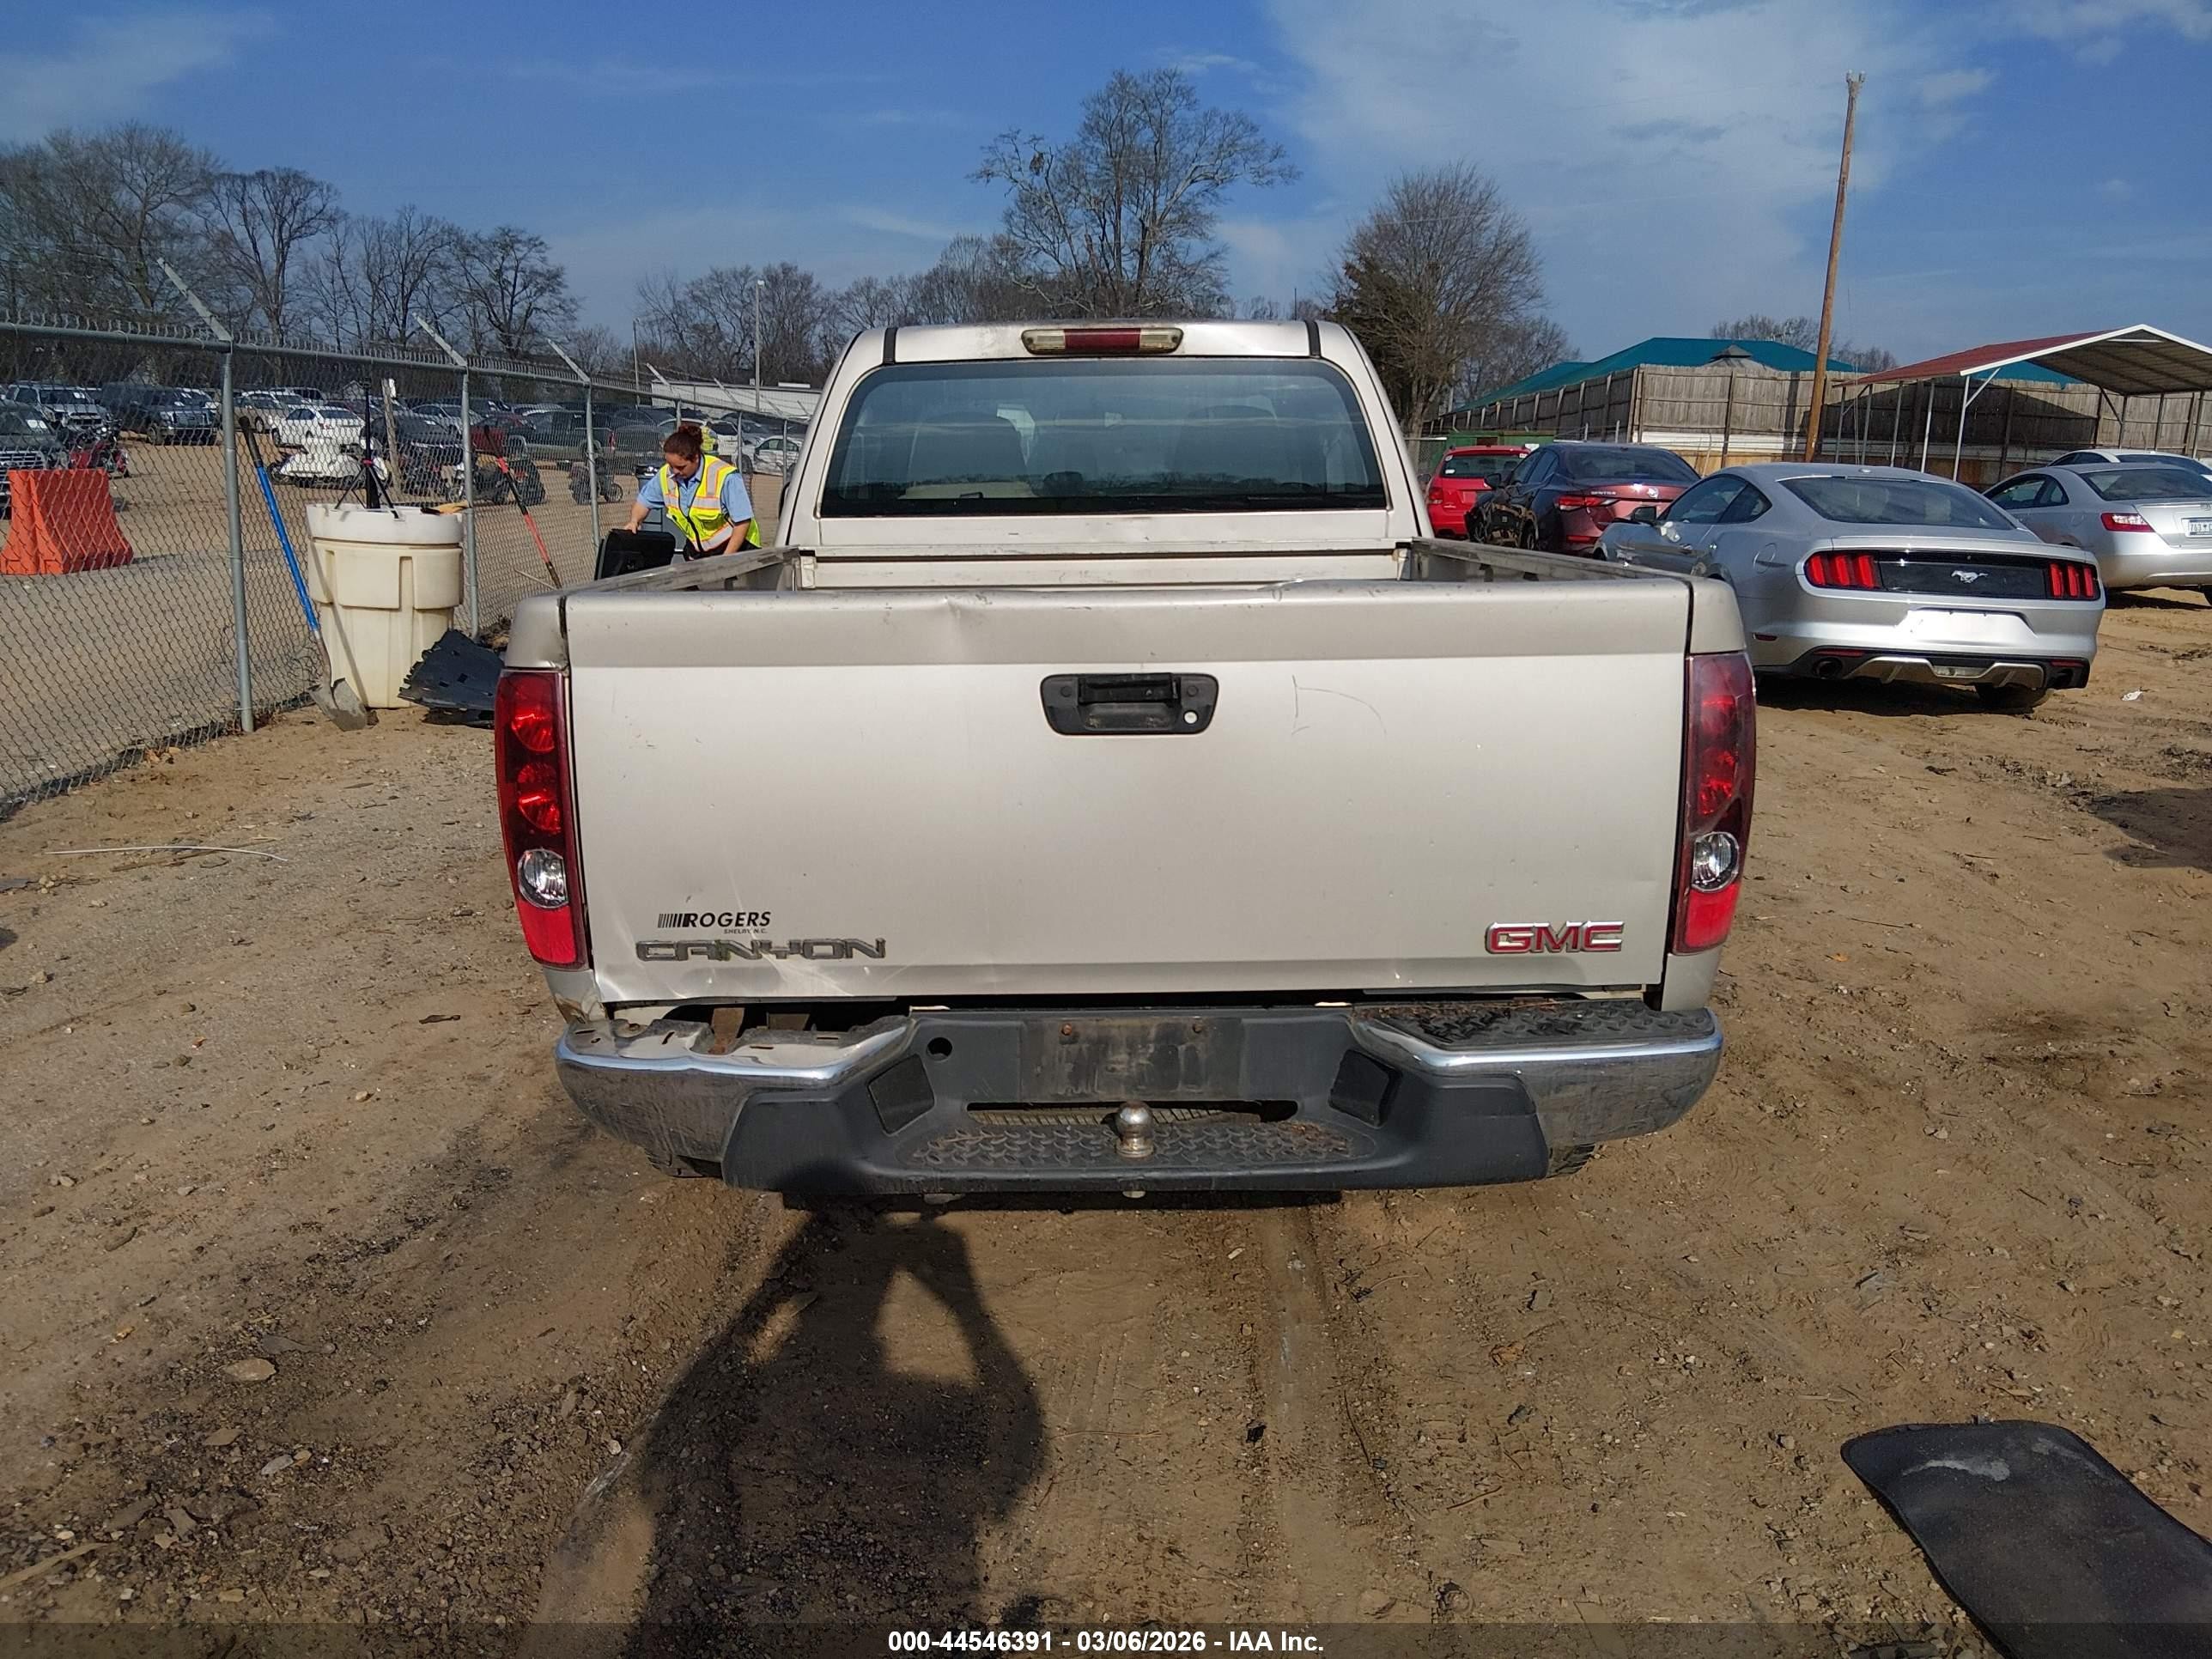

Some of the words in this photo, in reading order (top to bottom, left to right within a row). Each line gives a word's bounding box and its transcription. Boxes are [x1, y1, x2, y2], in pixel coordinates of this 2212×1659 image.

[684, 912, 771, 927] ROGERS
[1485, 921, 1625, 954] GMC
[635, 939, 886, 962] CANYON
